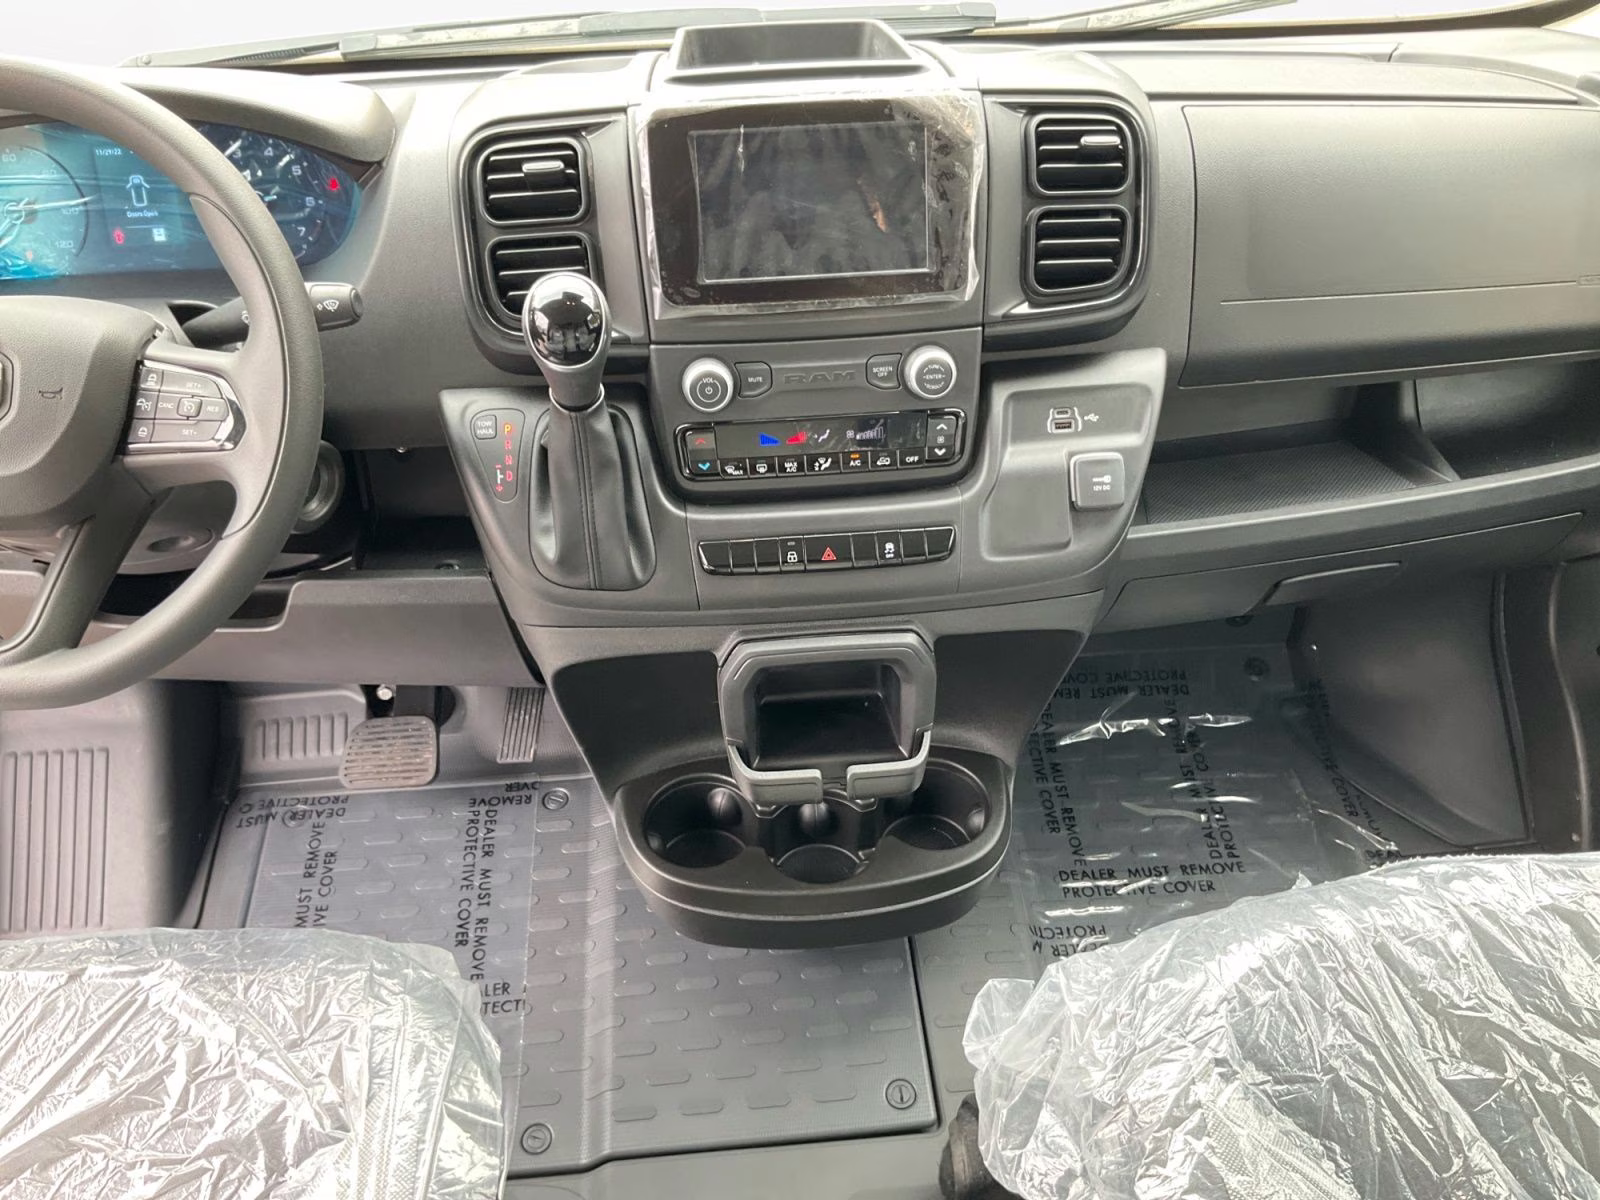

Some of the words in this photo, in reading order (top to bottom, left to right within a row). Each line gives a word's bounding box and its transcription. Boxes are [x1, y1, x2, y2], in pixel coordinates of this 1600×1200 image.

[263, 147, 273, 156] 4
[291, 165, 302, 175] 5
[305, 196, 316, 207] 6
[297, 226, 306, 236] 7
[784, 370, 856, 385] RAM
[477, 420, 493, 428] TOW
[504, 424, 512, 435] P
[505, 440, 512, 450] R
[505, 455, 513, 465] N
[849, 459, 861, 467] A/C
[506, 471, 513, 481] D
[1090, 685, 1129, 699] MUST
[1137, 684, 1190, 697] DEALER
[258, 795, 349, 811] PROTECTIVE
[468, 794, 532, 809] REMOVE
[289, 808, 346, 821] DEALER
[1037, 789, 1061, 835] COVER
[1050, 762, 1070, 799] MUST
[1061, 807, 1087, 867] REMOVE
[236, 811, 279, 829] MUST
[481, 809, 498, 859] DEALER
[303, 822, 326, 879] REMOVE
[461, 810, 480, 892] PROTECTIVE
[318, 850, 338, 897] COVER
[1058, 868, 1117, 882] DEALER
[1127, 865, 1170, 879] MUST
[1180, 861, 1246, 877] REMOVE
[477, 868, 493, 908] MUST
[1163, 880, 1216, 894] COVER
[294, 888, 313, 928] MUST
[454, 898, 472, 948] COVER
[470, 917, 489, 981] REMOVE
[480, 982, 511, 998] LER
